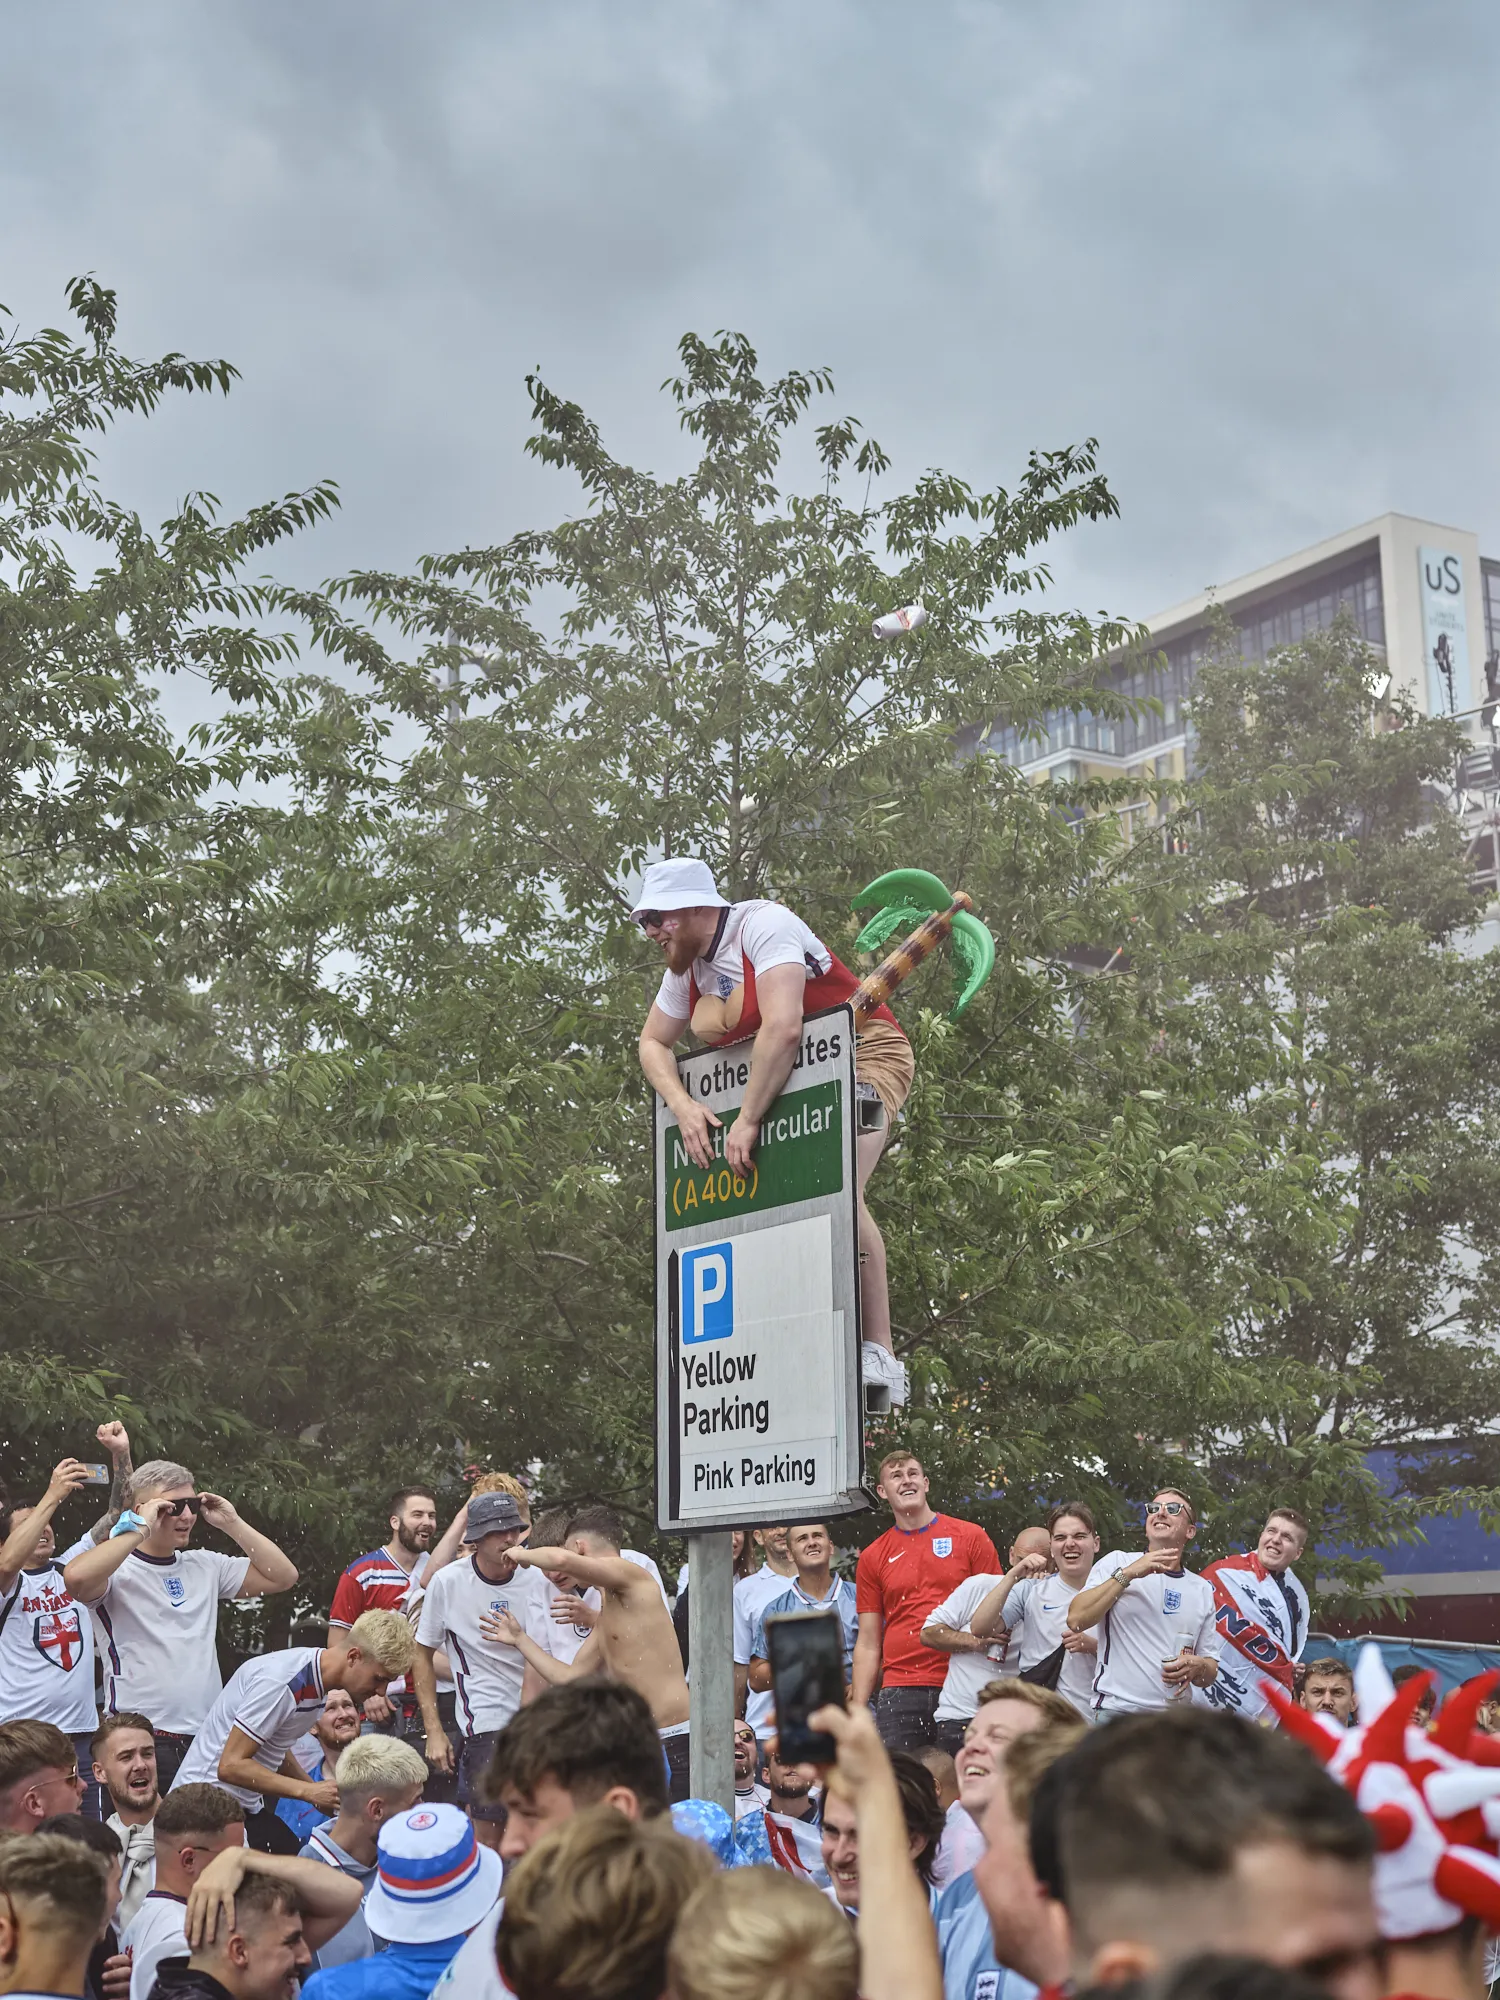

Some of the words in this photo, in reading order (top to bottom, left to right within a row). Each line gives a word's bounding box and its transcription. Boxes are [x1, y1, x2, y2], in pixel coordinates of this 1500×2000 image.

[700, 1060, 753, 1097] othe
[792, 1034, 841, 1070] utes
[760, 1103, 833, 1147] ircular
[693, 1253, 727, 1337] P
[681, 1350, 757, 1390] Yellow
[683, 1395, 769, 1437] Parking
[694, 1460, 734, 1492] Pink
[741, 1453, 816, 1486] Parking
